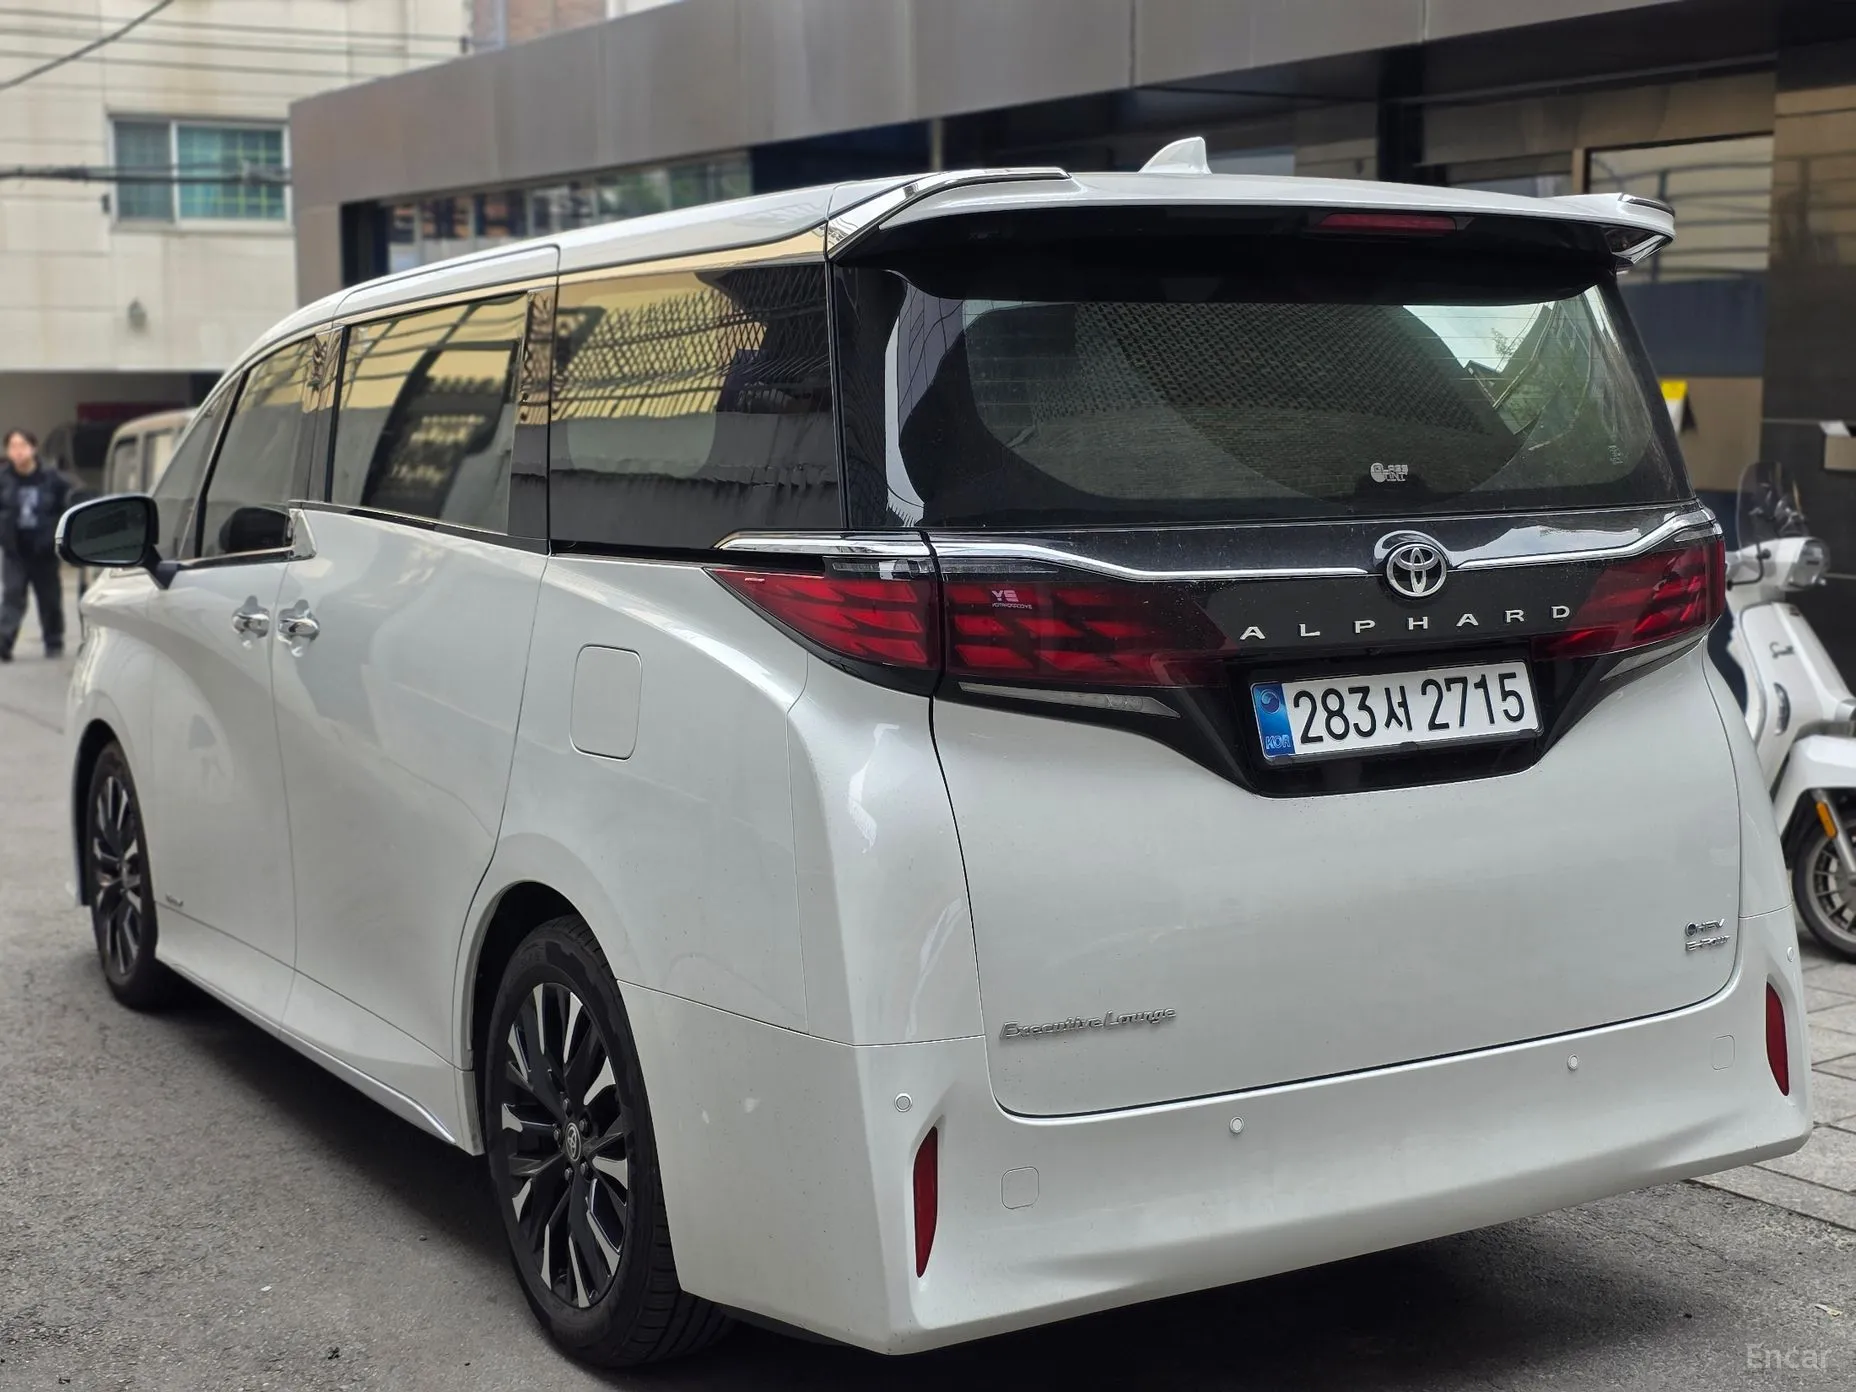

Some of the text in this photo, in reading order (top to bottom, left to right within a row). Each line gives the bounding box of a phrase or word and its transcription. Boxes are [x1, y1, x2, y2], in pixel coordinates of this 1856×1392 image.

[1240, 605, 1571, 640] ALPHARD
[1265, 734, 1291, 750] KOR
[1000, 1007, 1177, 1040] Executive Lounge
